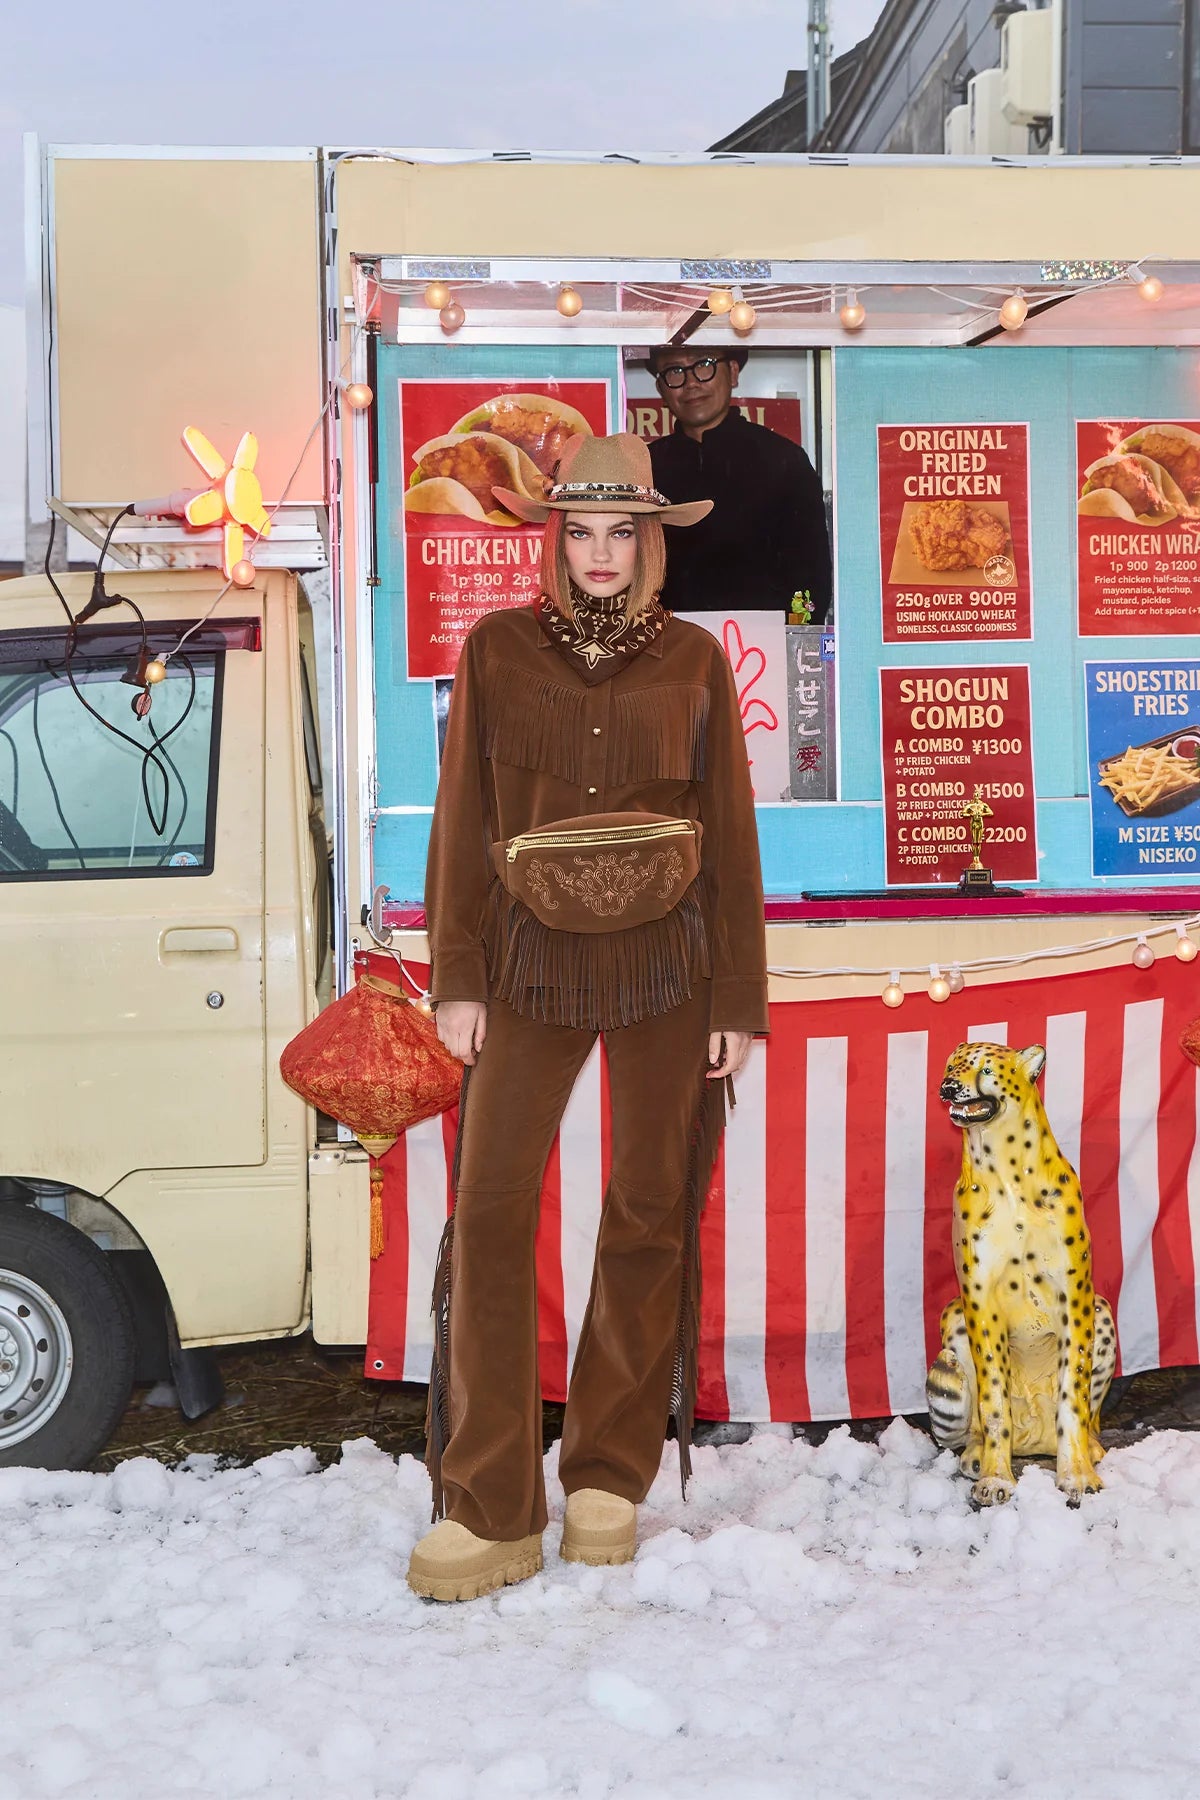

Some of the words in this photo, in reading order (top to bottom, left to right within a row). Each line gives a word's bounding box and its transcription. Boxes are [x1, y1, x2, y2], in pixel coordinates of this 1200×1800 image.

[899, 429, 1008, 452] ORIGINAL
[921, 452, 987, 474] FRIED
[903, 475, 1001, 497] CHICKEN
[1089, 534, 1161, 556] CHICKEN
[421, 538, 521, 566] CHICKEN
[1110, 561, 1123, 573] 1p
[1127, 560, 1148, 571] 900
[1155, 560, 1169, 573] 2p
[1171, 560, 1197, 571] 1200
[450, 573, 468, 588] 1p
[473, 573, 503, 586] 900
[512, 573, 531, 588] 2p
[1094, 575, 1116, 584] Fried
[1118, 575, 1151, 584] chicken
[429, 591, 459, 602] Fried
[462, 591, 507, 602] chicken
[510, 591, 537, 602] half-
[1102, 586, 1154, 595] mayonnaise,
[896, 592, 930, 608] 250g
[932, 594, 963, 606] OVER
[969, 591, 1016, 606] 900円
[1141, 596, 1171, 606] pickles
[896, 611, 926, 622] USING
[928, 610, 979, 621] HOKKAIDO
[981, 609, 1017, 620] WHEAT
[1094, 607, 1112, 616] Add
[1113, 607, 1137, 615] tartar
[1150, 607, 1163, 615] hot
[1165, 607, 1187, 616] spice
[440, 621, 476, 630] musta
[897, 625, 939, 634] BONELESS,
[940, 624, 973, 633] CLASSIC
[974, 622, 1017, 632] GOODNESS
[429, 634, 453, 644] Add
[899, 677, 1009, 703] SHOGUN
[1133, 694, 1189, 716] FRIES
[910, 704, 1004, 730] COMBO
[894, 739, 905, 753] A
[908, 737, 964, 753] COMBO
[972, 738, 1022, 755] ¥1300
[894, 757, 905, 766] 1P
[906, 756, 932, 766] FRIED
[934, 755, 971, 765] CHICKEN
[903, 767, 936, 776] POTATO
[896, 783, 906, 798] B
[910, 781, 965, 797] COMBO
[896, 801, 907, 810] 2P
[909, 801, 935, 810] FRIED
[936, 800, 972, 809] CHICKE
[897, 811, 923, 821] WRAP
[897, 828, 907, 842] C
[911, 826, 967, 842] COMBO
[983, 827, 1027, 843] 2200
[1118, 827, 1134, 844] M
[1136, 826, 1170, 844] SIZE
[897, 846, 909, 855] 2P
[910, 845, 936, 854] FRIED
[1138, 847, 1197, 864] NISEKO
[905, 855, 939, 865] POTATO
